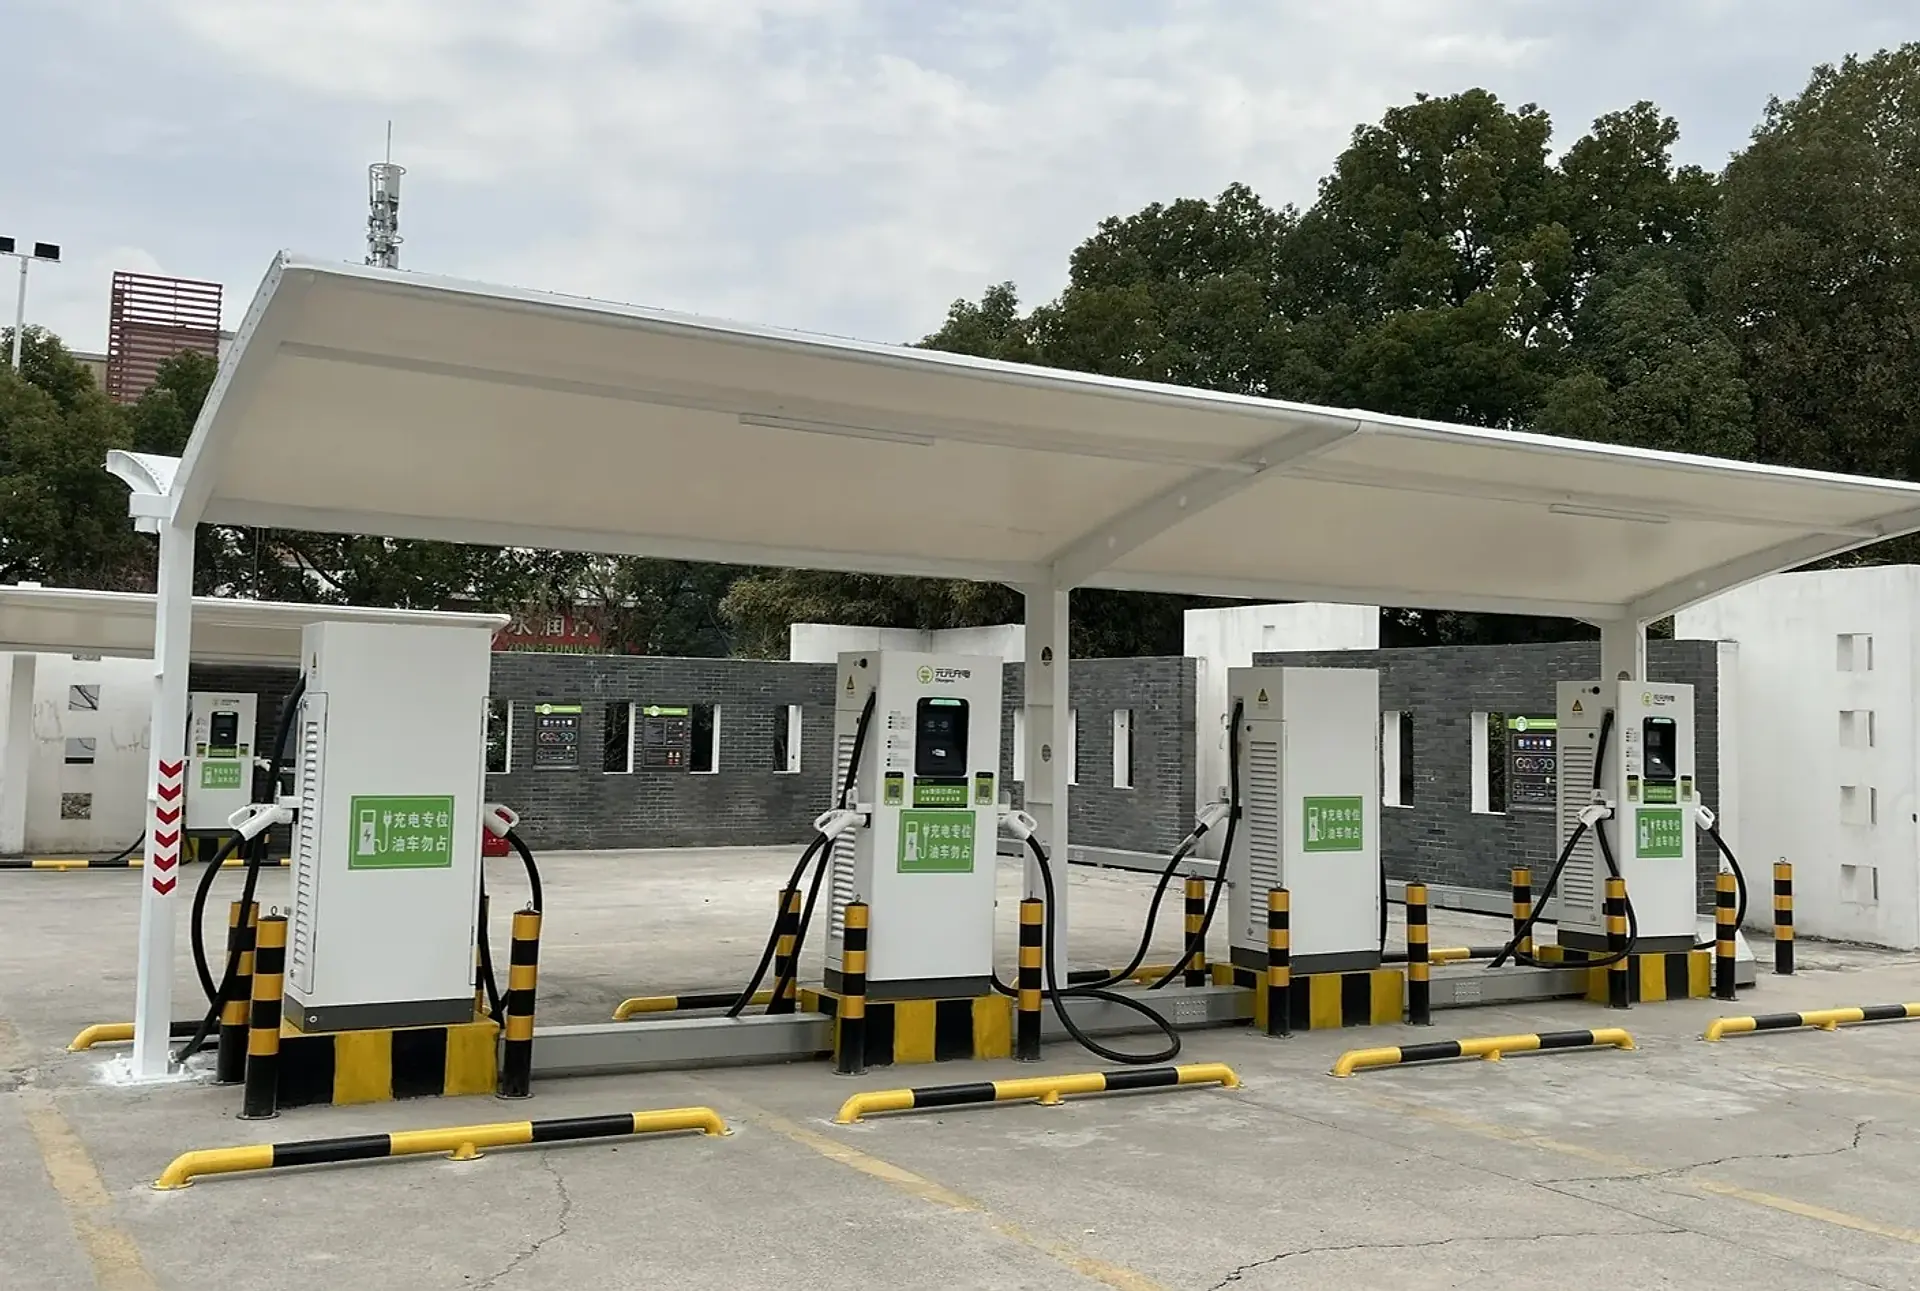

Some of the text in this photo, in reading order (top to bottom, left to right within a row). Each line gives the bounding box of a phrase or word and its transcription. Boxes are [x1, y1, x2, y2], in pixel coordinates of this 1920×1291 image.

[393, 811, 448, 828] 充电专位
[930, 824, 972, 838] 充电专位
[392, 835, 447, 852] 油车勿占
[929, 845, 970, 859] 油车勿占
